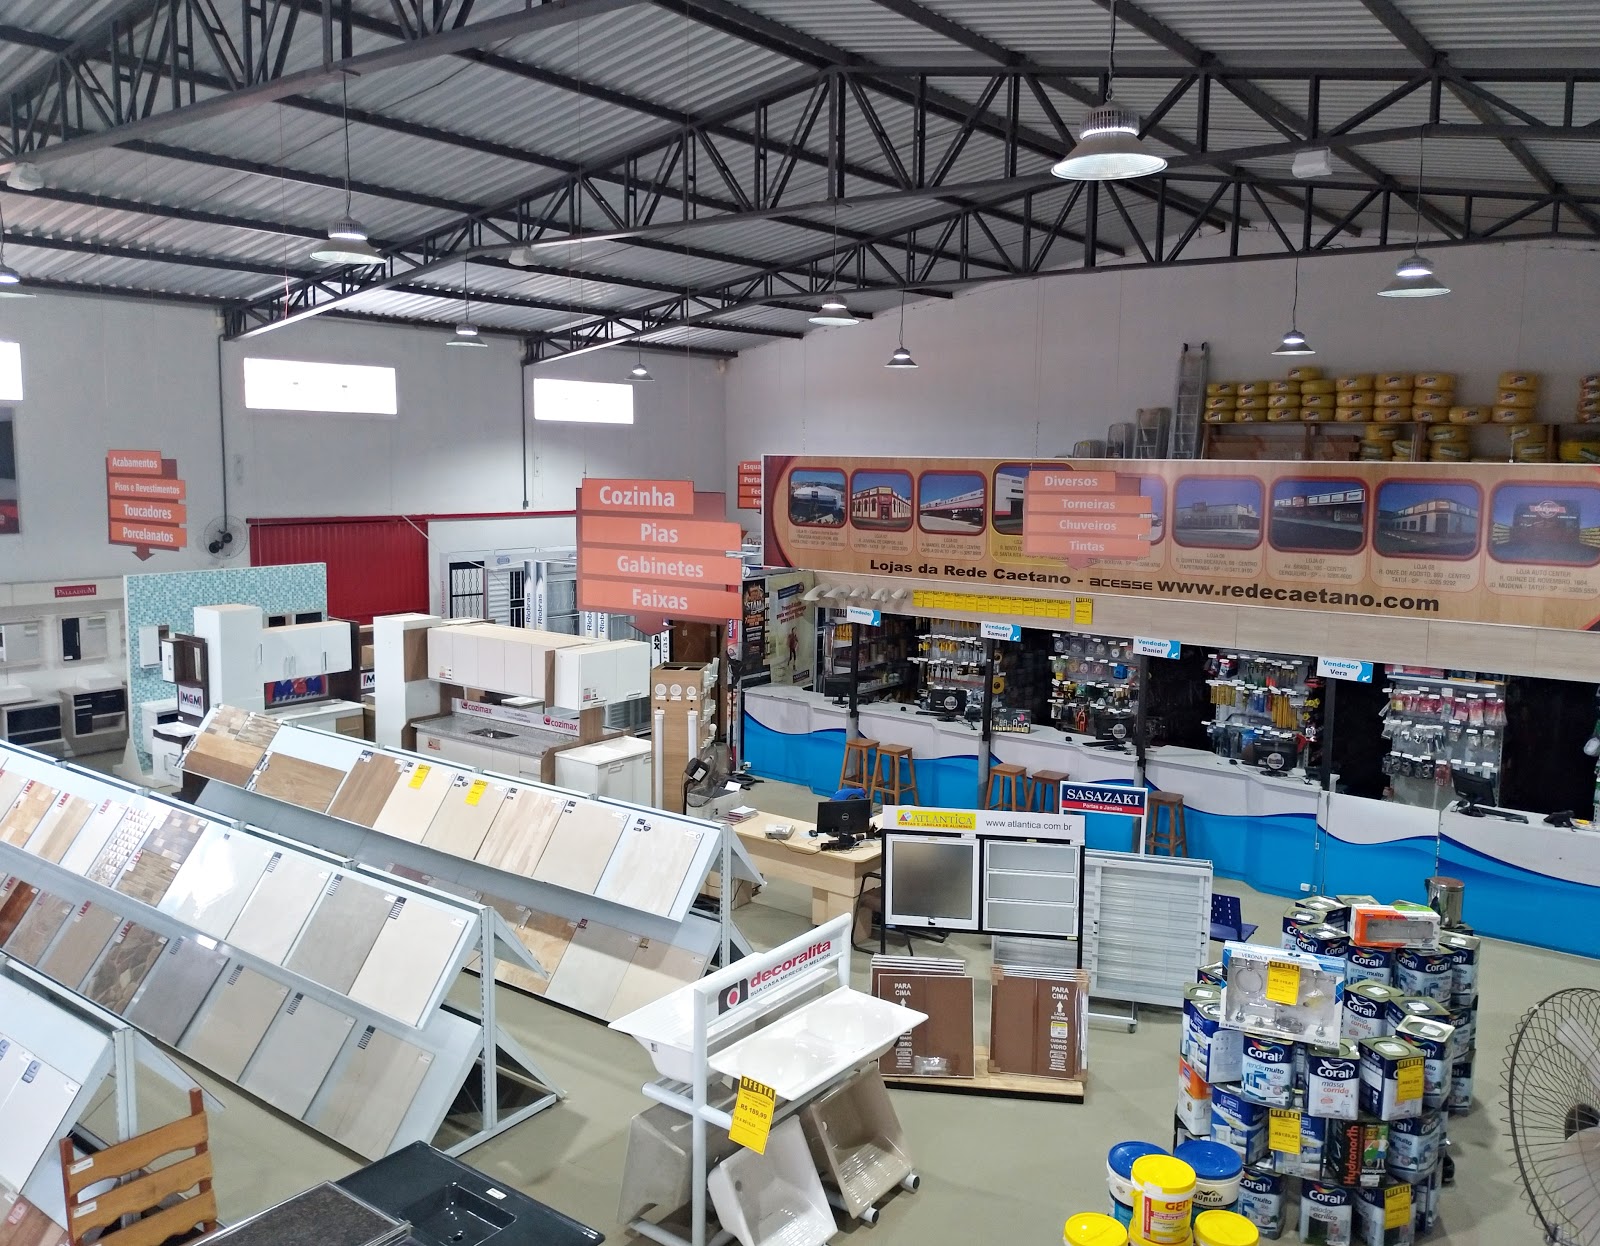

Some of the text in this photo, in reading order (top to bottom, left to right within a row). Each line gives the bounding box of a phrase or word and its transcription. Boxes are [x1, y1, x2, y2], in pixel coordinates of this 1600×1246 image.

[112, 457, 158, 469] Acabamentos
[1044, 476, 1098, 487] Diversos
[114, 482, 130, 492] Pisos
[136, 483, 180, 495] Revestimentos
[599, 485, 675, 508] Cozinha
[1061, 499, 1116, 510] Torneiras
[123, 504, 172, 519] Toucadores
[1059, 519, 1117, 531] Chuveiros
[122, 527, 174, 543] Porcelanatos
[640, 522, 679, 544] Pias
[1069, 540, 1105, 552] Tintas
[616, 555, 704, 578] Gabinetes
[1447, 572, 1471, 580] CENTRO
[870, 559, 913, 574] Lojas
[918, 563, 938, 575] da
[944, 565, 988, 578] Rede
[993, 568, 1071, 585] Caetano
[1089, 577, 1153, 591] acesse
[1156, 580, 1439, 612] www.redecaetano.com
[632, 588, 688, 611] Faixas
[984, 623, 1011, 631] Vendedor
[987, 630, 1008, 638] Samuel
[1137, 638, 1169, 648] Vendedor
[1142, 646, 1163, 654] Daniel
[1322, 660, 1359, 670] Vendedor
[1330, 668, 1348, 677] Vera
[468, 703, 493, 715] cozimax
[551, 719, 578, 732] cozimax
[1066, 788, 1140, 806] SASAZAKI
[1082, 802, 1099, 810] Portas
[1103, 804, 1123, 812] Janelas
[985, 818, 1073, 832] www.atlantica.com.br
[1296, 938, 1315, 953] Coral
[1324, 945, 1345, 956] Coral
[750, 940, 831, 988] decoralita
[1351, 954, 1380, 967] Coral
[1425, 962, 1447, 972] Coral
[750, 987, 763, 997] SUA
[763, 978, 779, 990] CASA
[780, 966, 803, 981] MERECE
[809, 952, 831, 967] MELHOR
[894, 982, 912, 990] PARA
[1051, 985, 1070, 994] PARA
[1051, 993, 1069, 1001] CIMA
[1346, 1000, 1372, 1017] Coral
[1350, 1020, 1372, 1031] corrida
[1050, 1043, 1068, 1051] VIDRO
[1247, 1046, 1279, 1062] Coral
[1317, 1066, 1349, 1079] Coral
[743, 1077, 774, 1100] OFERTA
[1323, 1087, 1350, 1095] corrida
[1216, 1103, 1242, 1120] Kem Tone
[1271, 1109, 1300, 1120] OFERTA
[1343, 1125, 1360, 1185] Hydronorth
[1308, 1190, 1341, 1205] Coral
[1310, 1205, 1334, 1214] selador
